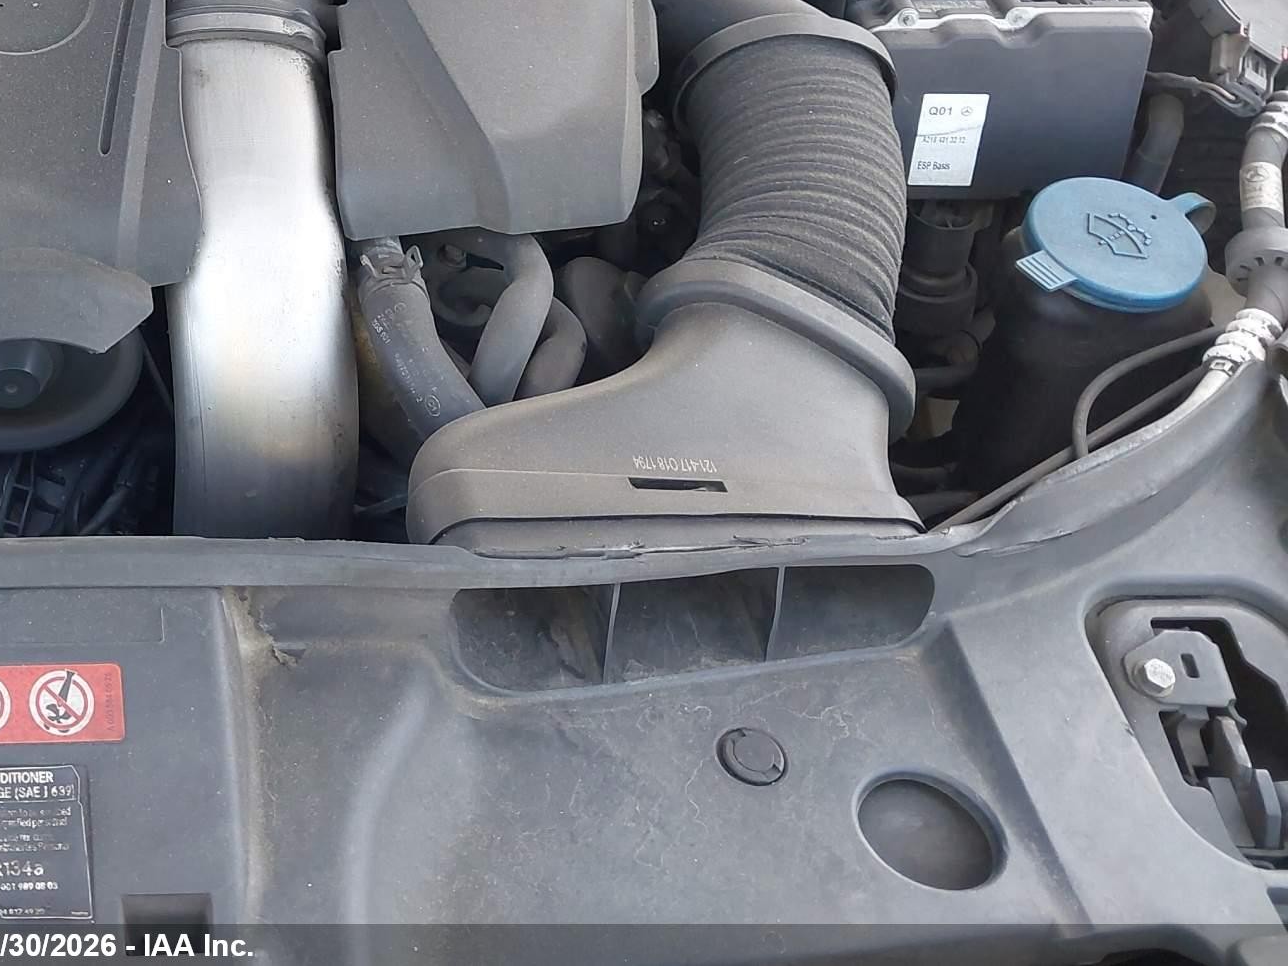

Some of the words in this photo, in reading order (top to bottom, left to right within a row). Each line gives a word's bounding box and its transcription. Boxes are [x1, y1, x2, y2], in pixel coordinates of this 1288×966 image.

[928, 106, 953, 116] Q01
[916, 161, 931, 170] ESP
[680, 458, 718, 473] 121-417
